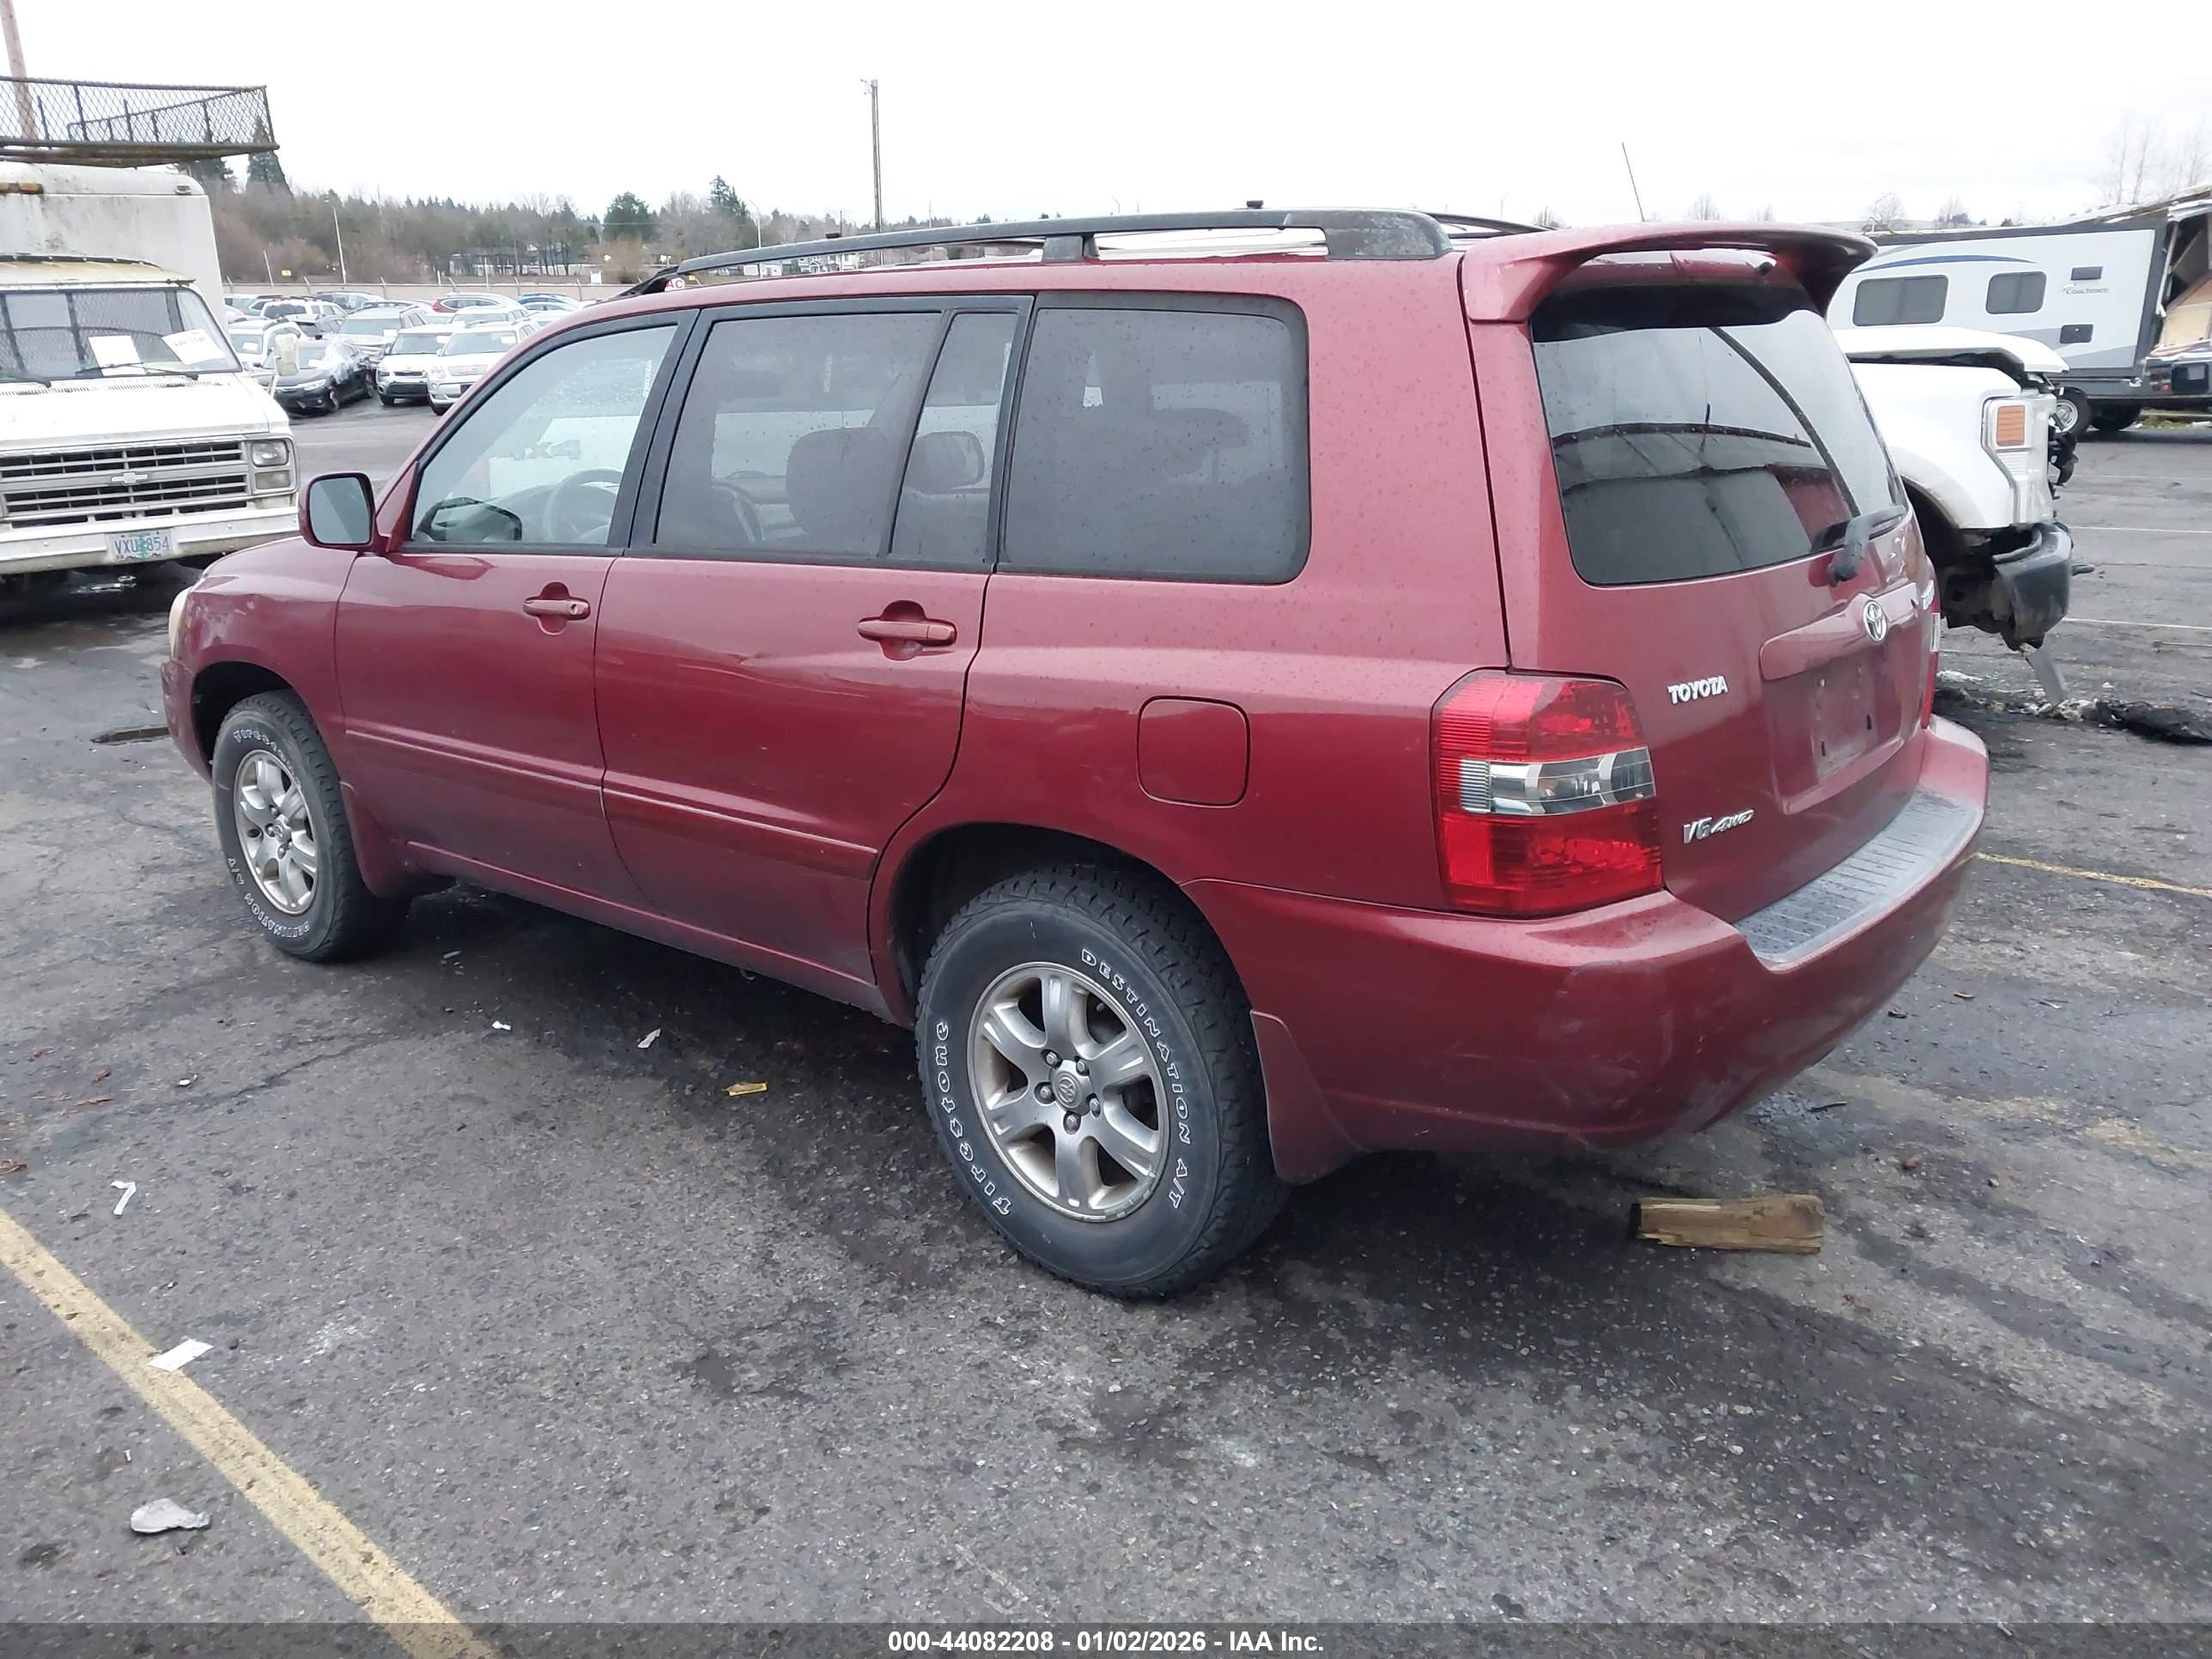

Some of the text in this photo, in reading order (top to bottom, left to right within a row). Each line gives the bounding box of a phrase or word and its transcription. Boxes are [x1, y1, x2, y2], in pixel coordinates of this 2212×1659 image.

[114, 536, 170, 554] VXU 854
[1668, 676, 1729, 704] TOYOTA
[1684, 817, 1712, 844] V6
[1081, 948, 1191, 1209] DESTINATION A/T
[935, 1022, 1012, 1215] Firestone
